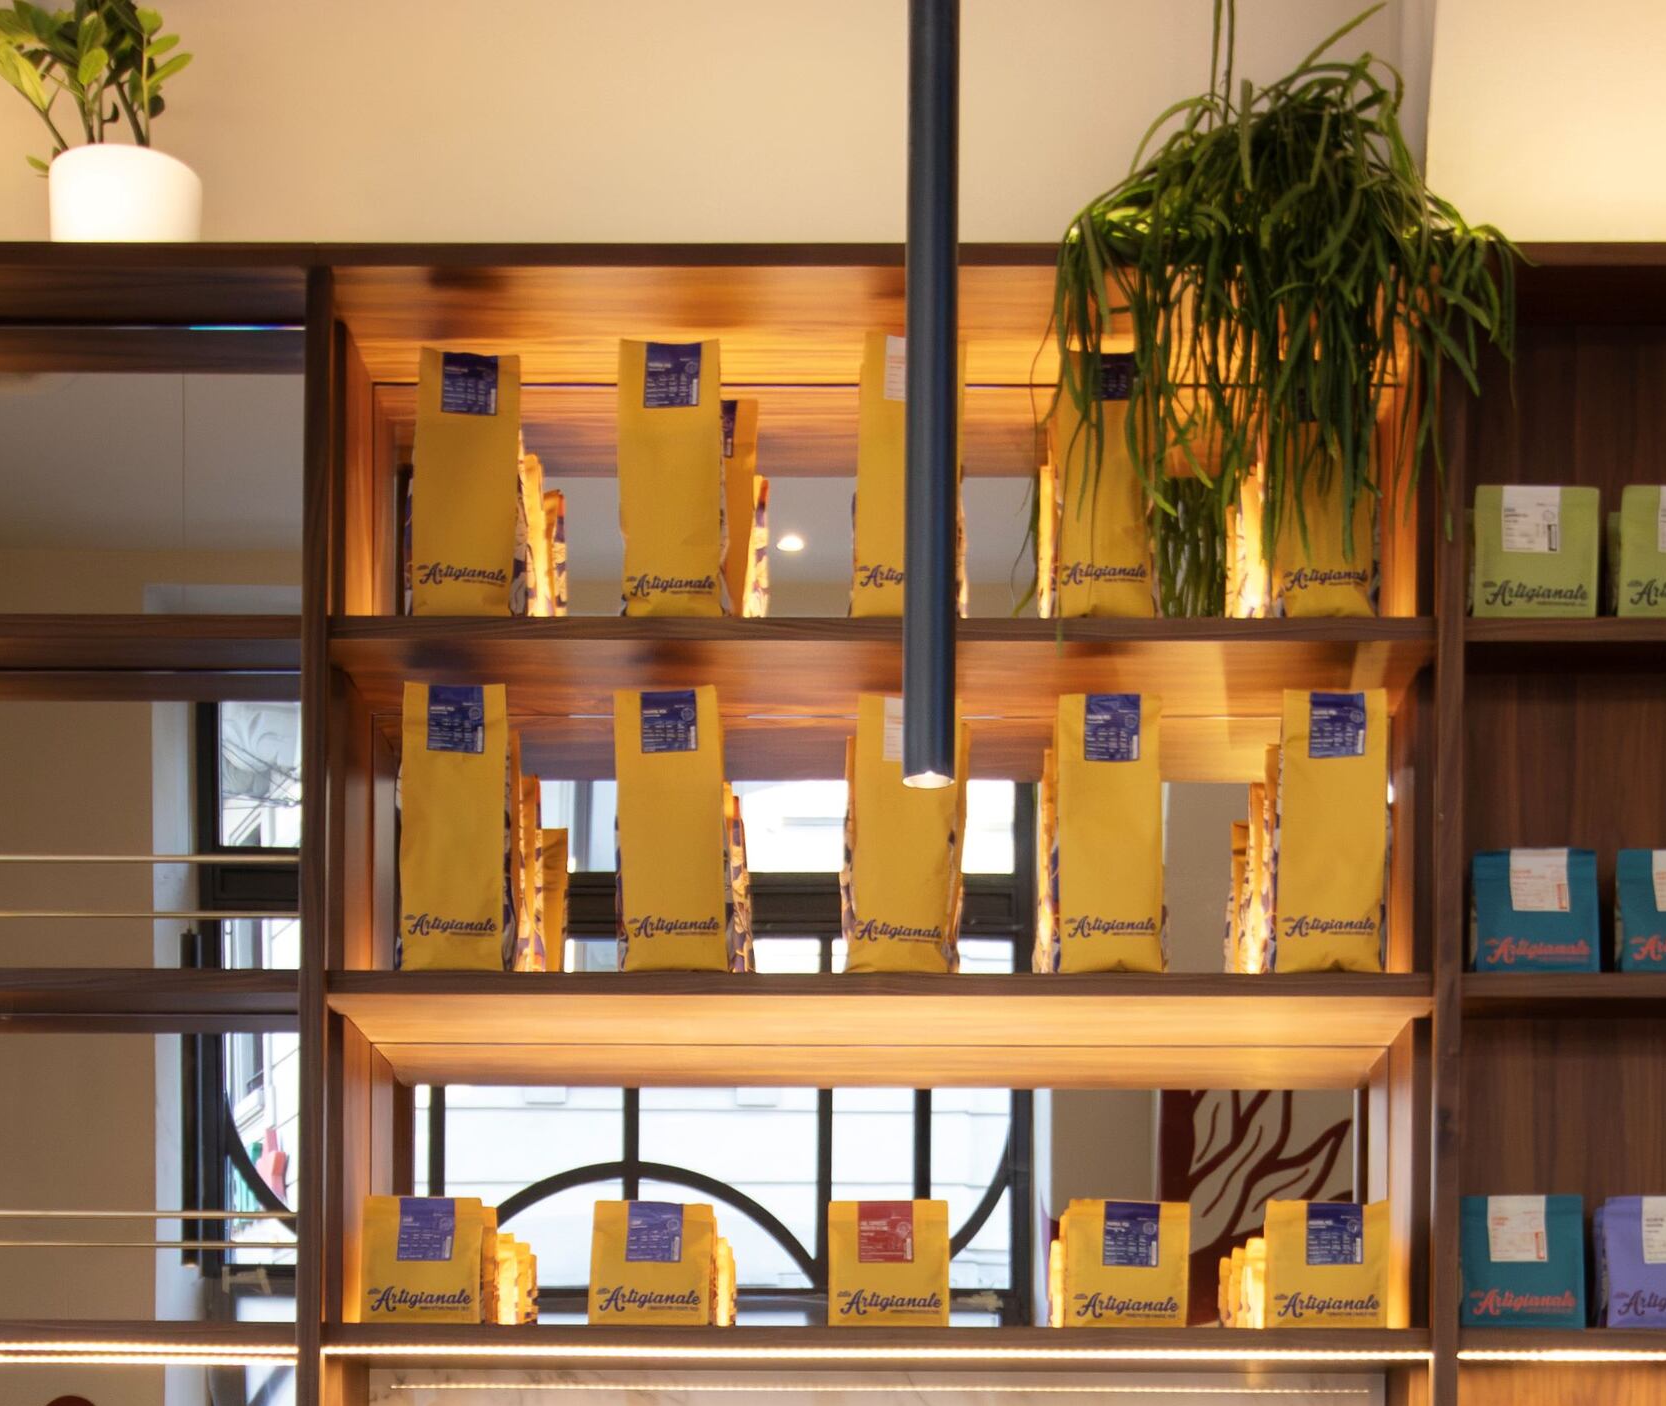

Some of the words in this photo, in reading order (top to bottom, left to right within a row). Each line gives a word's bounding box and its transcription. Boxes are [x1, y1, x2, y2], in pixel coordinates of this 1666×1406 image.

[371, 1286, 473, 1312] Artigianale
[599, 1285, 701, 1314] Artigianale
[839, 1288, 943, 1316] Artigianale
[1076, 1291, 1180, 1319] Artigianale
[1276, 1291, 1381, 1319] Artigianale
